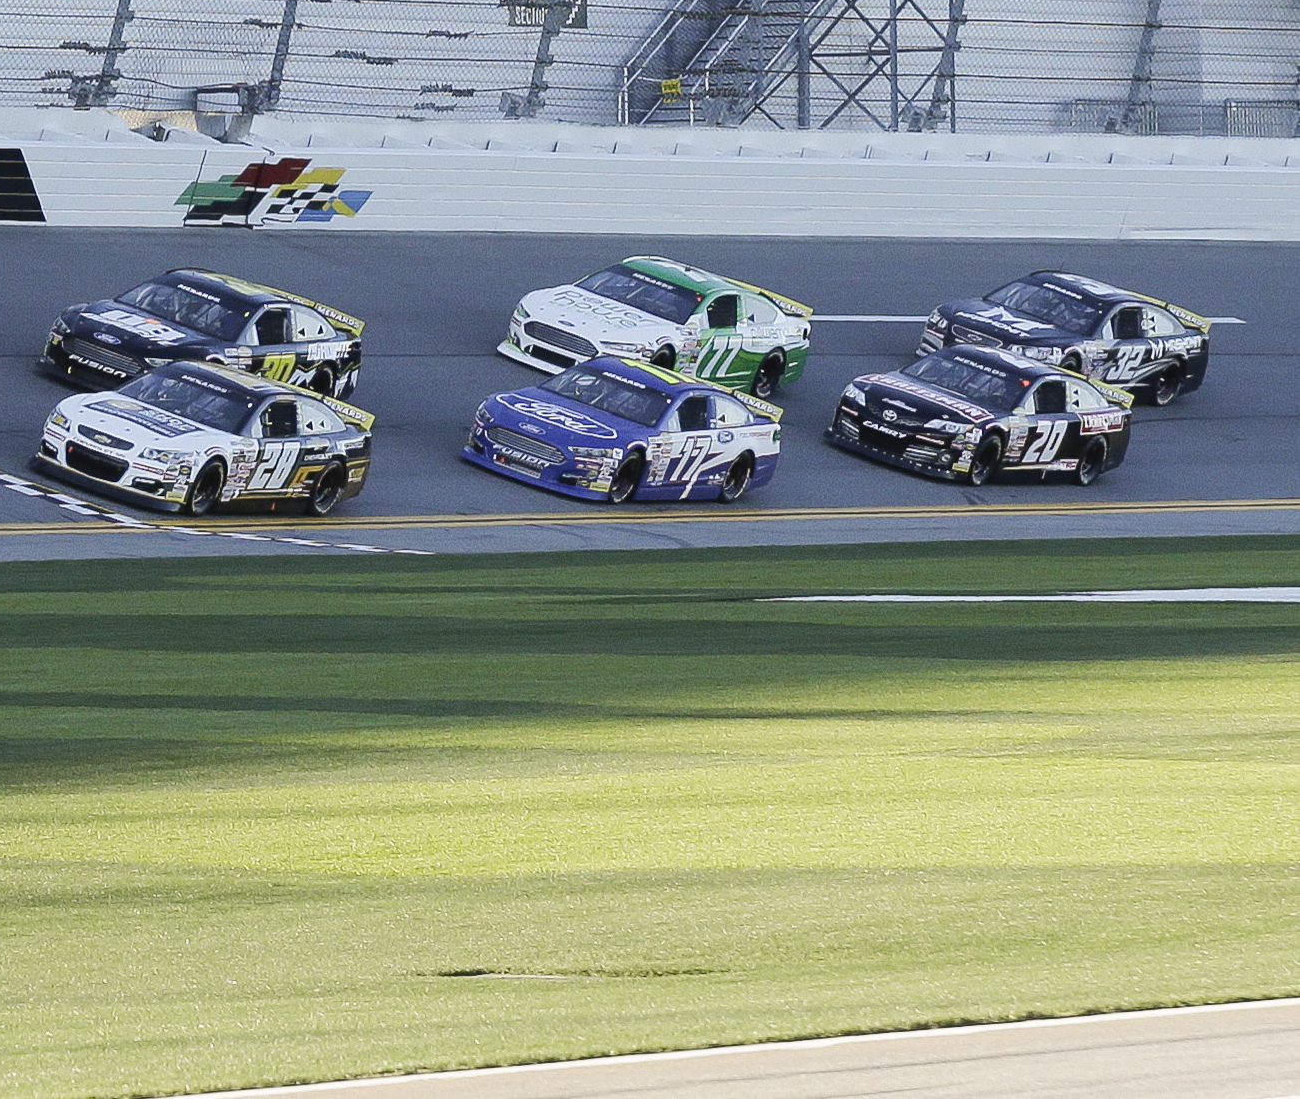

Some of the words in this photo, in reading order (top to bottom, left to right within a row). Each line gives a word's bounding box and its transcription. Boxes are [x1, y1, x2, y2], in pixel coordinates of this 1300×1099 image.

[68, 353, 127, 378] FUSION
[1106, 346, 1147, 380] 32
[514, 401, 599, 432] Ford
[863, 419, 907, 439] CAMRY
[669, 435, 713, 482] 17
[1021, 420, 1069, 463] 20
[247, 441, 301, 489] 28
